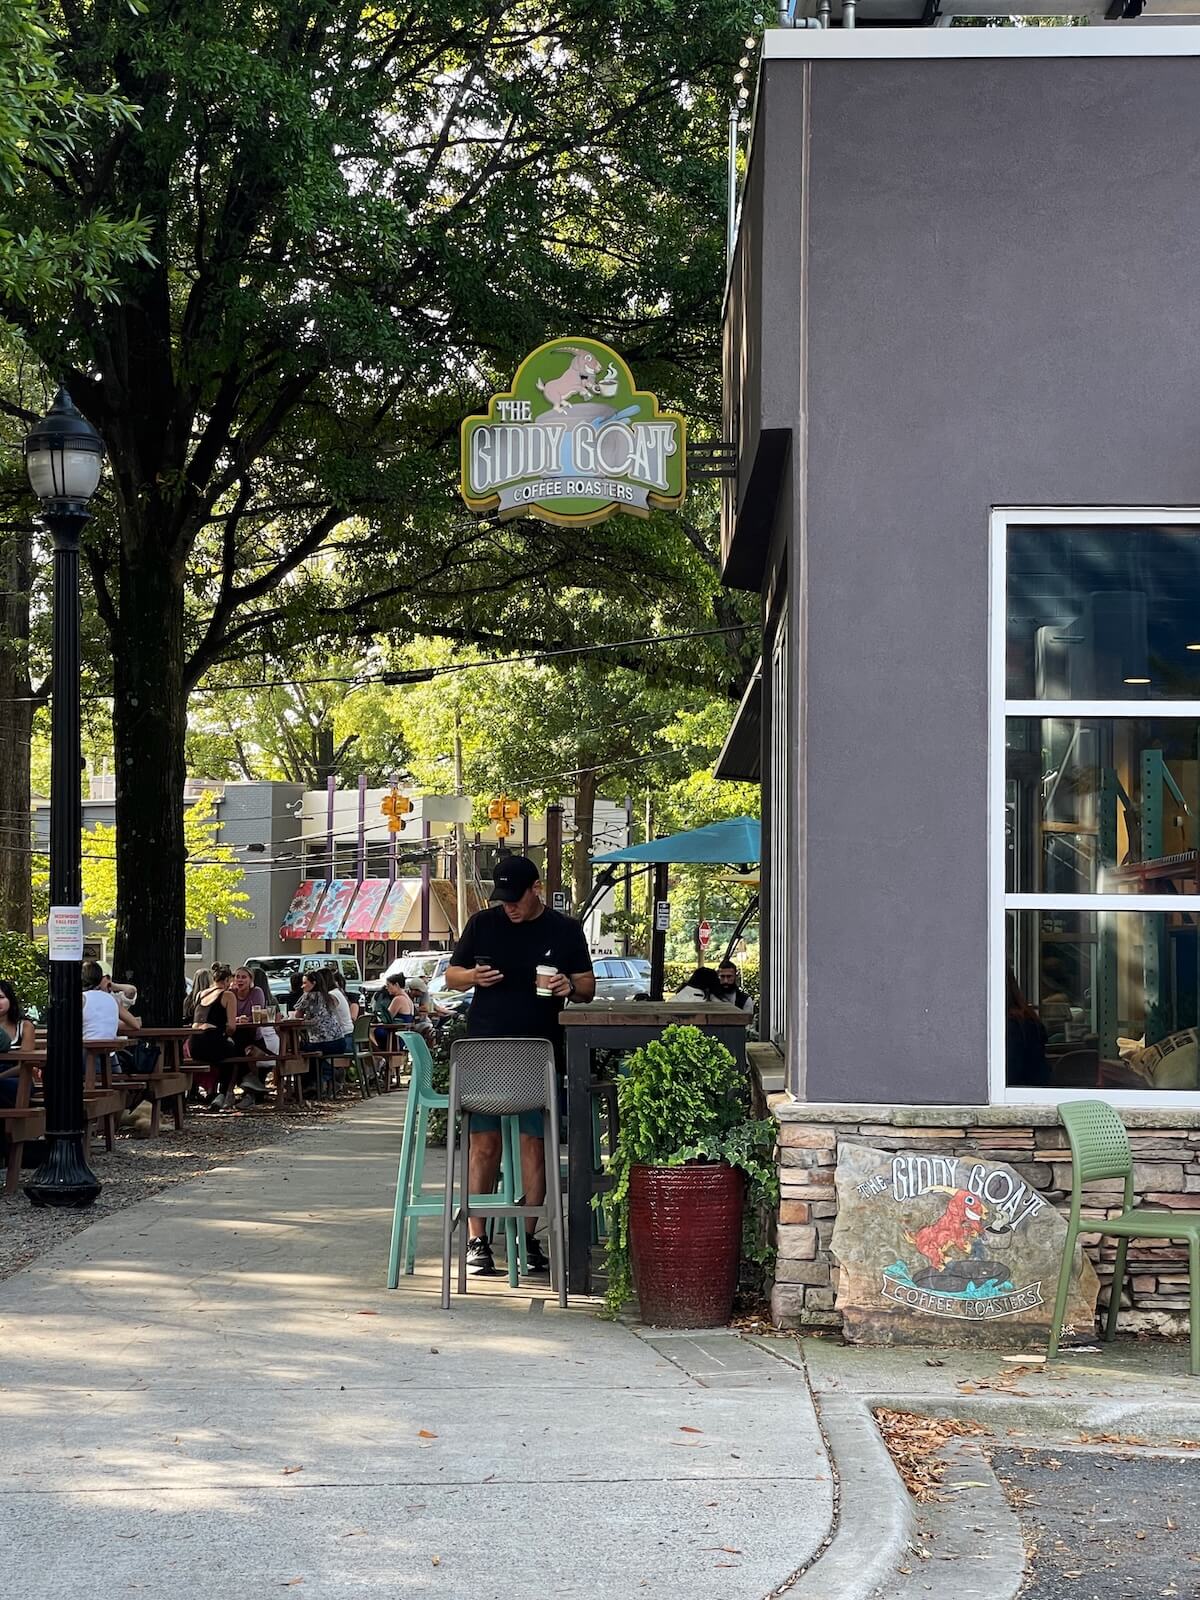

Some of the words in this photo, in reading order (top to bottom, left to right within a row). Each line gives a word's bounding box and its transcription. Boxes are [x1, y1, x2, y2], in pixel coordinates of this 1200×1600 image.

[496, 400, 532, 422] THE
[471, 424, 567, 493] GIDDY
[571, 421, 678, 491] GOAT
[512, 480, 562, 502] COFFEE
[566, 480, 634, 501] ROASTERS
[856, 1175, 888, 1199] THE
[892, 1156, 960, 1202] GIDDY
[967, 1163, 1047, 1232] GOAT
[894, 1285, 953, 1312] COFFEE
[965, 1290, 1036, 1316] ROASTERS
